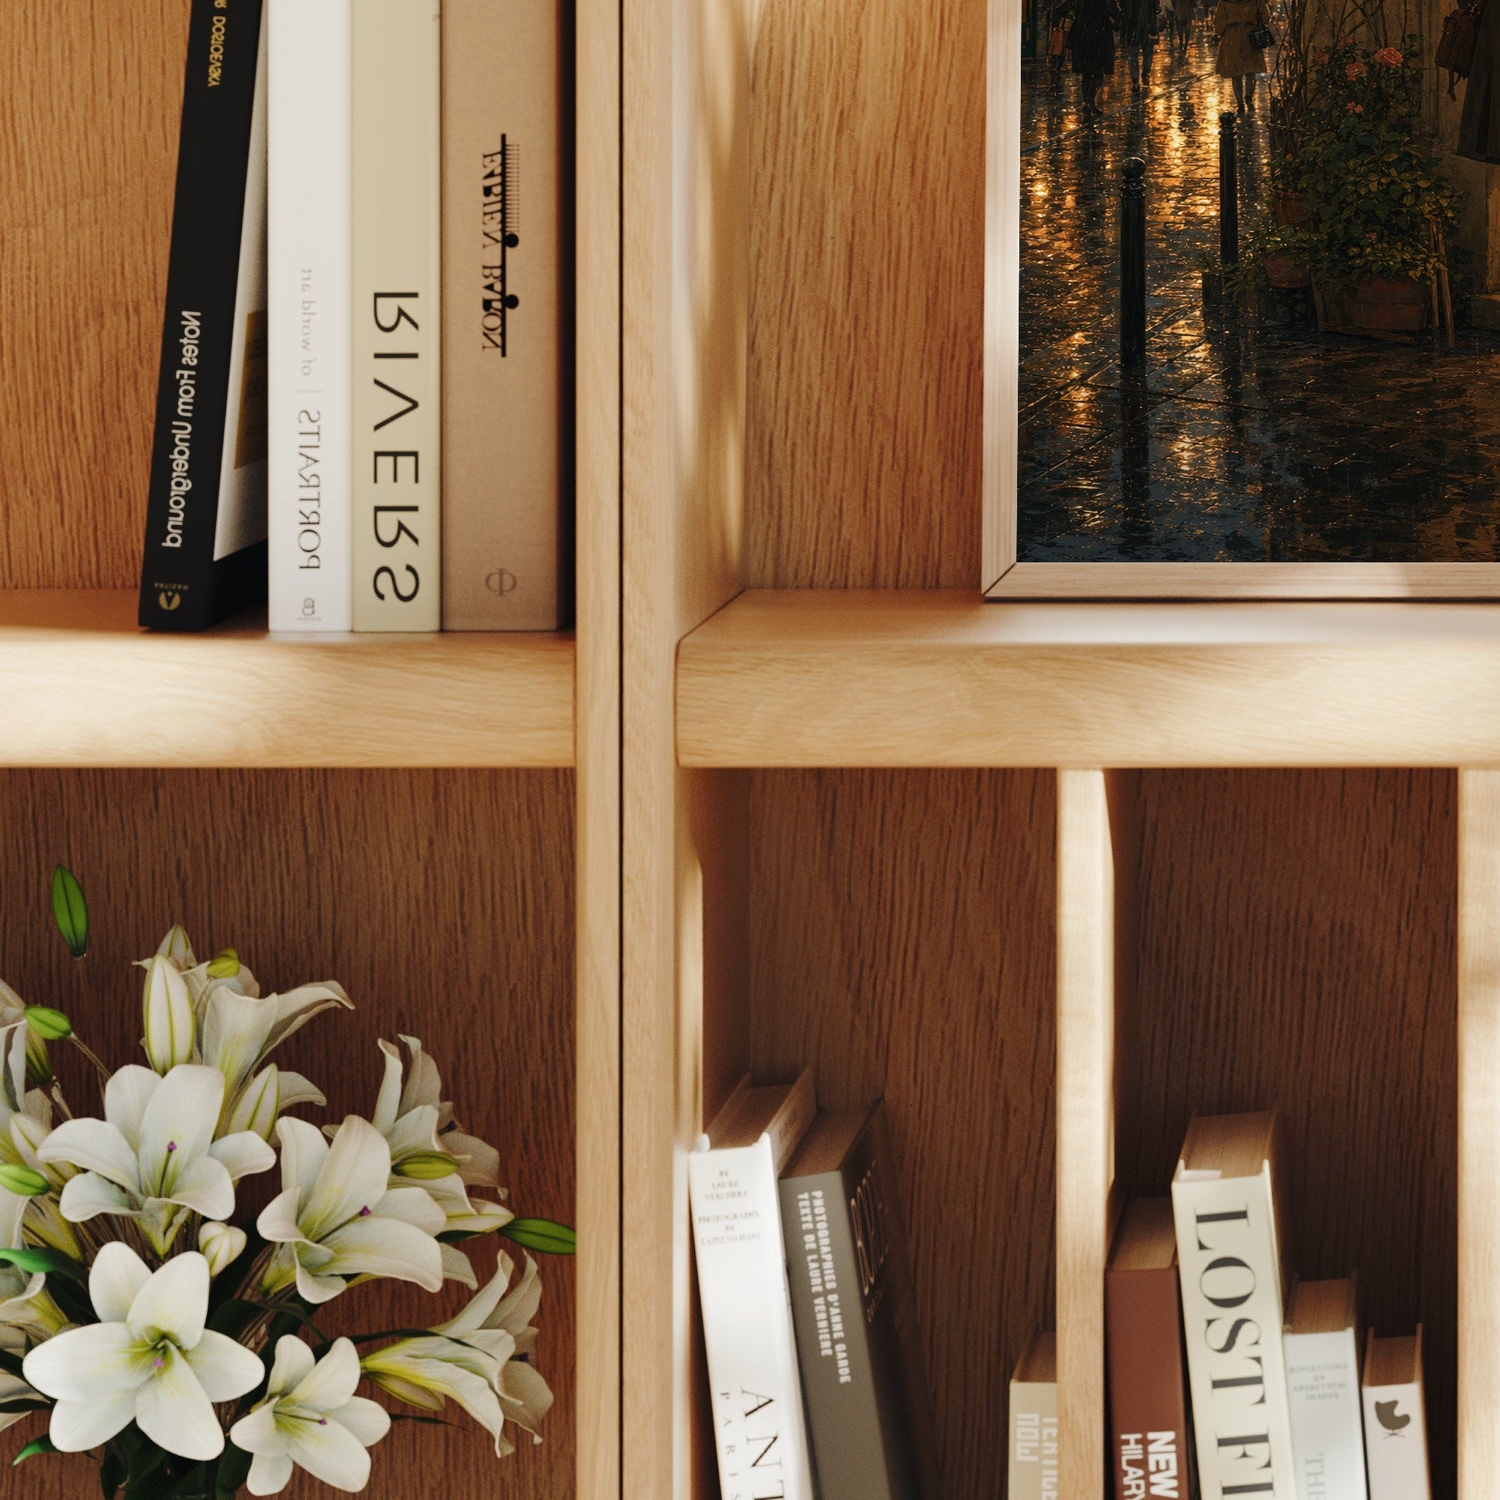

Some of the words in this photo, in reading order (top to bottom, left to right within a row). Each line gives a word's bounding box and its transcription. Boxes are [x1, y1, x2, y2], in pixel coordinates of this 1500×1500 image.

[797, 1191, 814, 1231] TEXTE
[803, 1233, 818, 1251] DE
[811, 1189, 838, 1291] PHOTOGRAPHIES
[806, 1254, 824, 1295] LAURE
[826, 1293, 845, 1340] D'ANNE
[1194, 1202, 1267, 1407] LOST
[834, 1343, 852, 1384] GARDE
[1147, 1430, 1179, 1499] NEW
